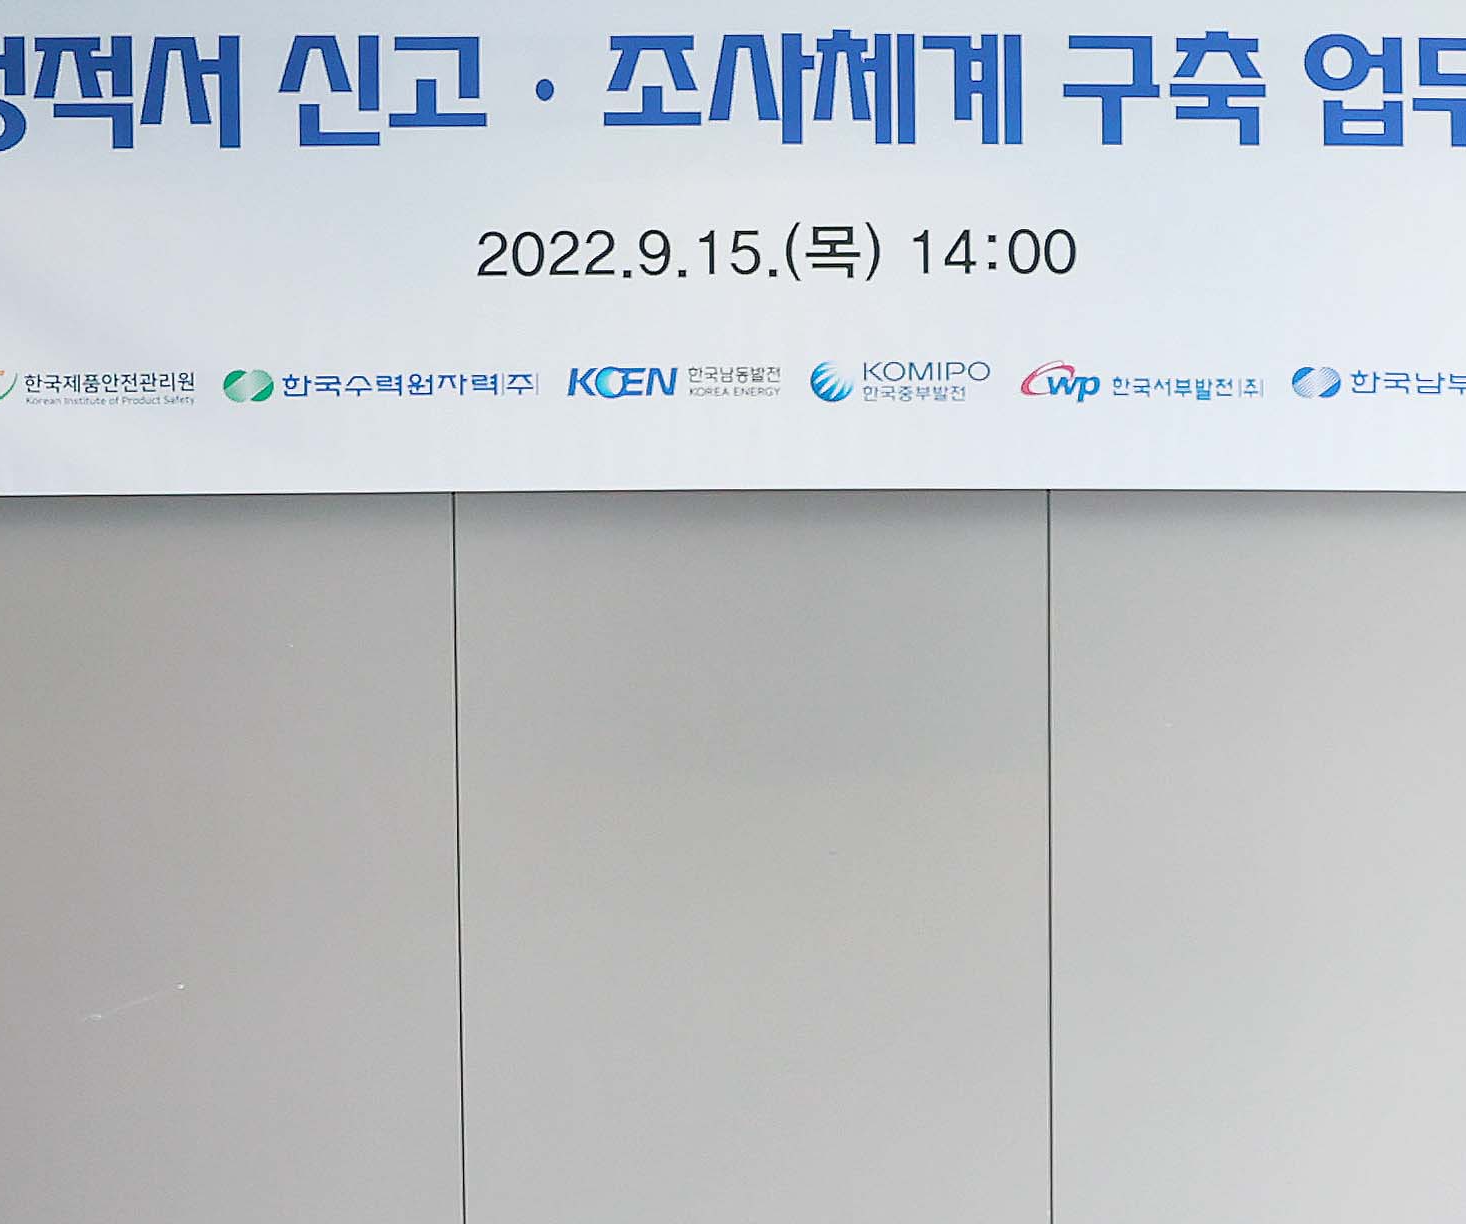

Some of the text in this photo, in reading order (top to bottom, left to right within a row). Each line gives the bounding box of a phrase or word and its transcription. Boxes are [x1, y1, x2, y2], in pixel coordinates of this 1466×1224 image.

[277, 34, 489, 148] 신고
[602, 29, 1024, 146] 조사체계
[1062, 31, 1268, 147] 구축
[476, 221, 1077, 283] 2022.9.15.(목) 14:00
[23, 371, 195, 394] 한국제품안전관리원
[567, 366, 678, 399] KOEN
[687, 366, 781, 384] 한국남동발전
[863, 360, 991, 383] KOMIPO
[689, 387, 781, 397] KOREA ENERGY
[862, 385, 967, 402] 한국중부발전
